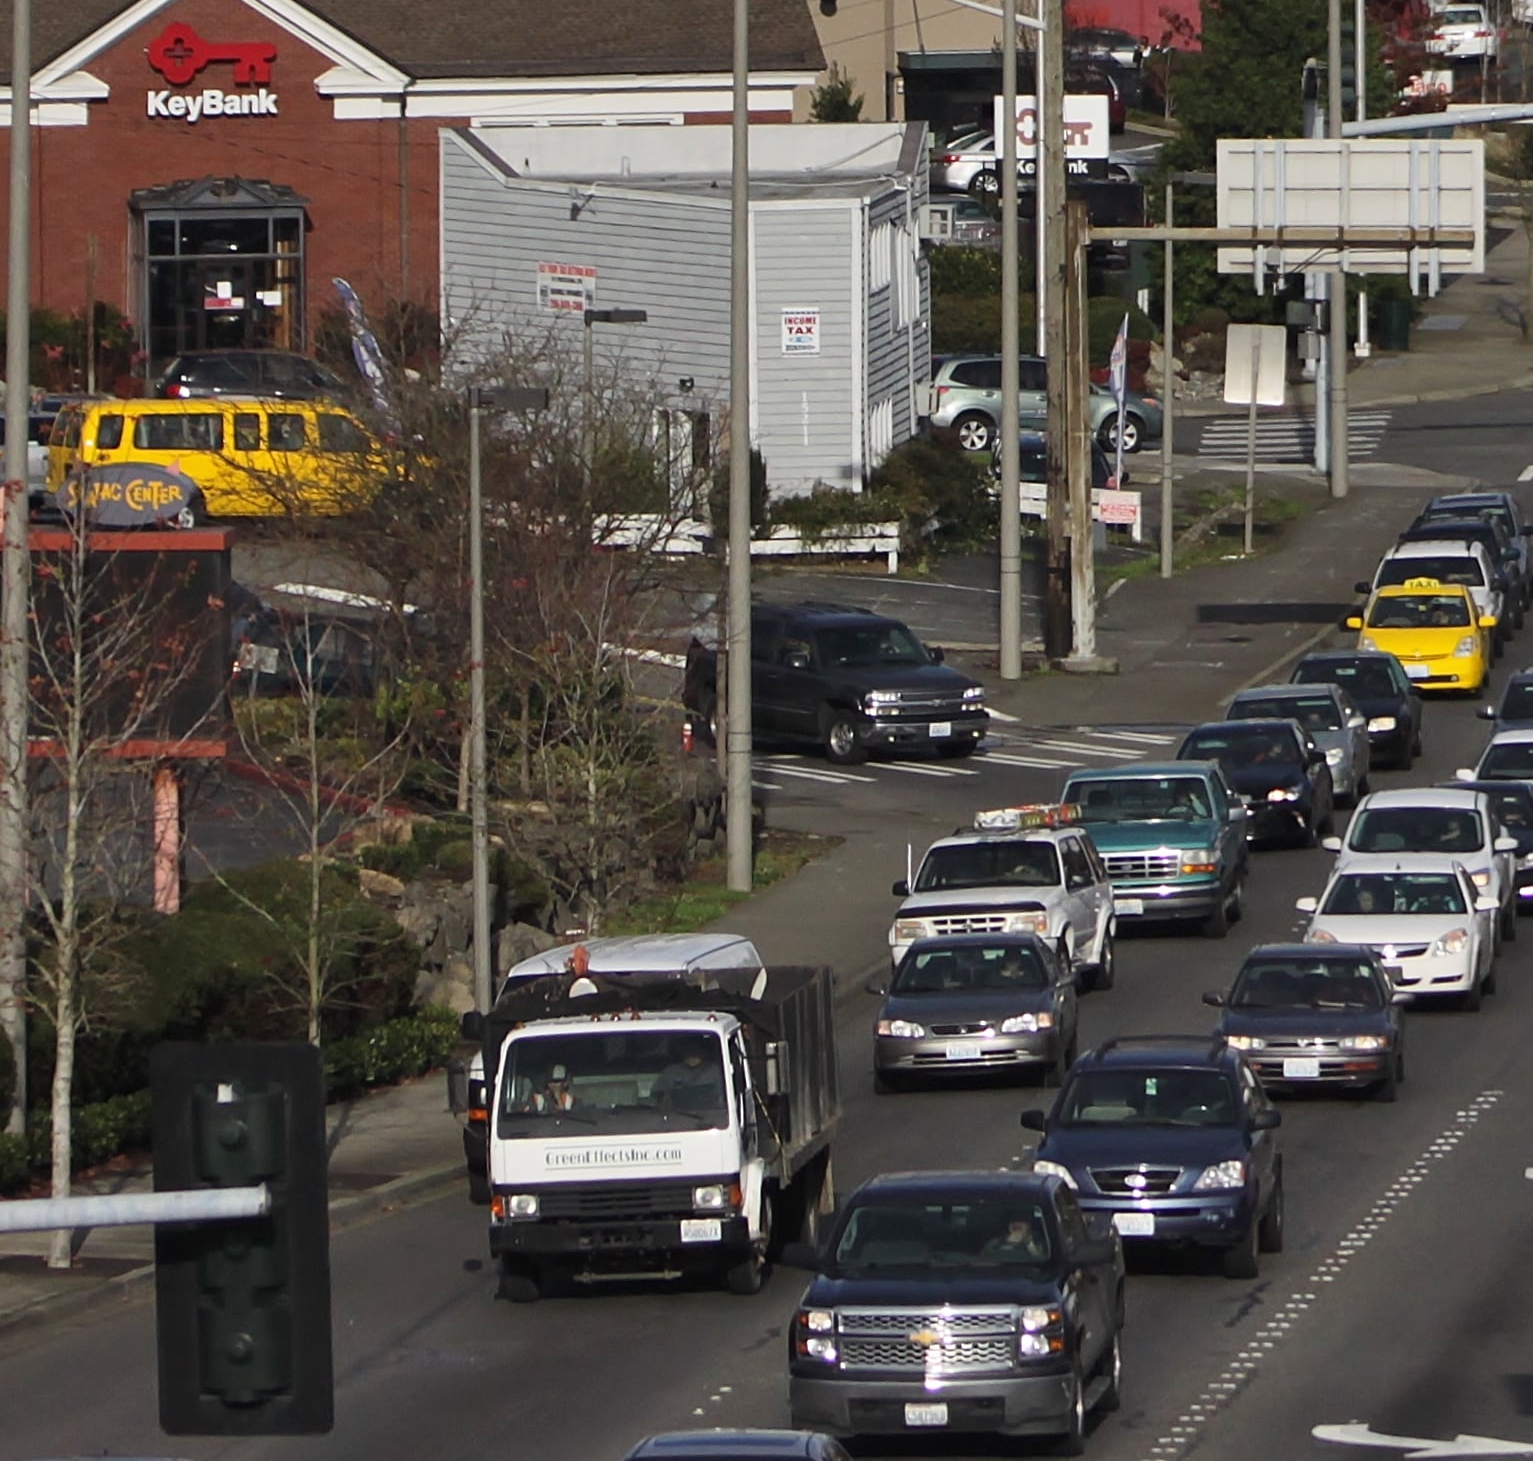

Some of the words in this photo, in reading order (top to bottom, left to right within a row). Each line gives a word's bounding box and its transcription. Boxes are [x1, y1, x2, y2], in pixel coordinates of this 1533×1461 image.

[147, 88, 278, 123] KeyBank
[784, 316, 817, 325] INCOME
[787, 326, 814, 335] TAX
[1408, 579, 1439, 589] TAXI
